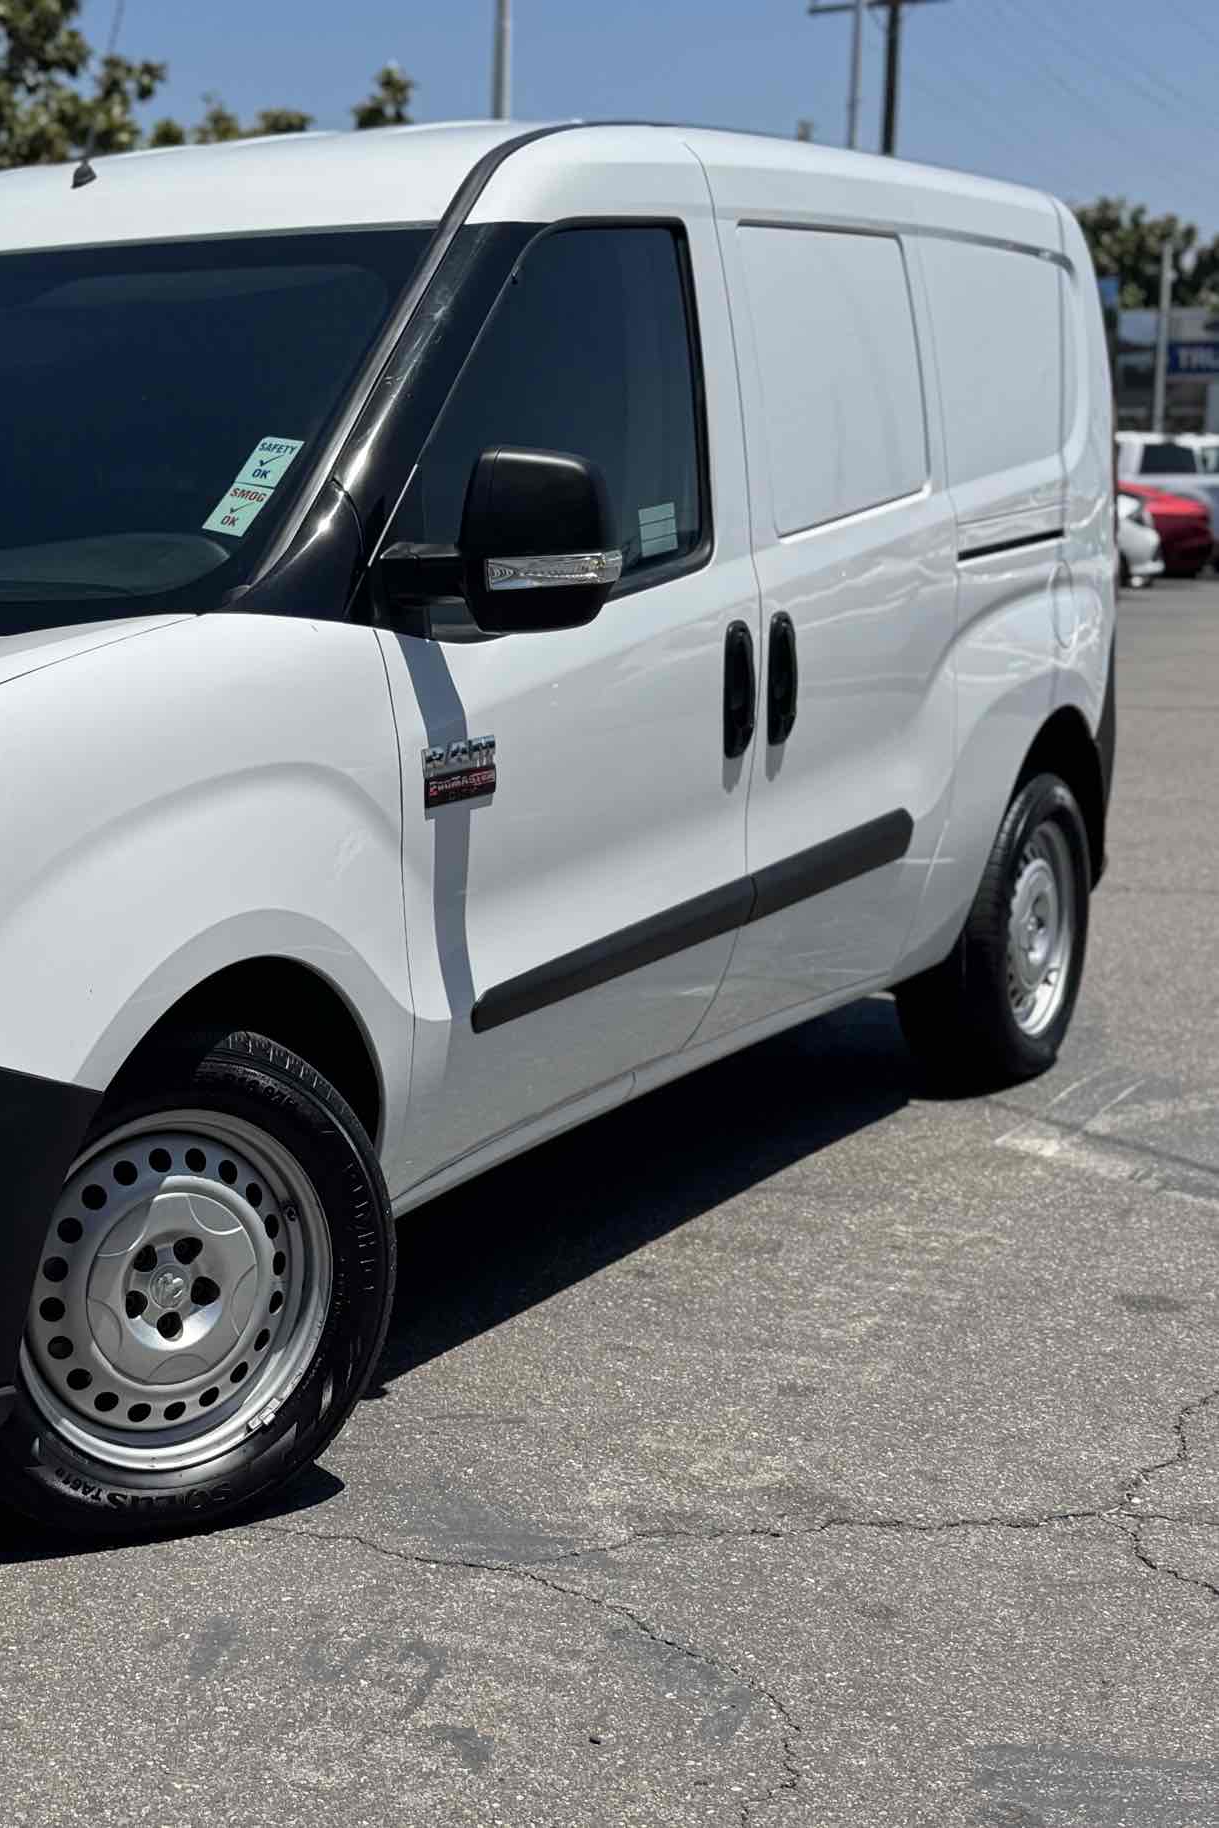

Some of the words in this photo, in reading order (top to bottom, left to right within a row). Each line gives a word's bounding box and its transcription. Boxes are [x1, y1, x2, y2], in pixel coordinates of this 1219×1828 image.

[258, 442, 298, 455] SAFETY
[252, 468, 271, 479] OK
[230, 487, 268, 503] SMOG
[221, 516, 239, 527] OK
